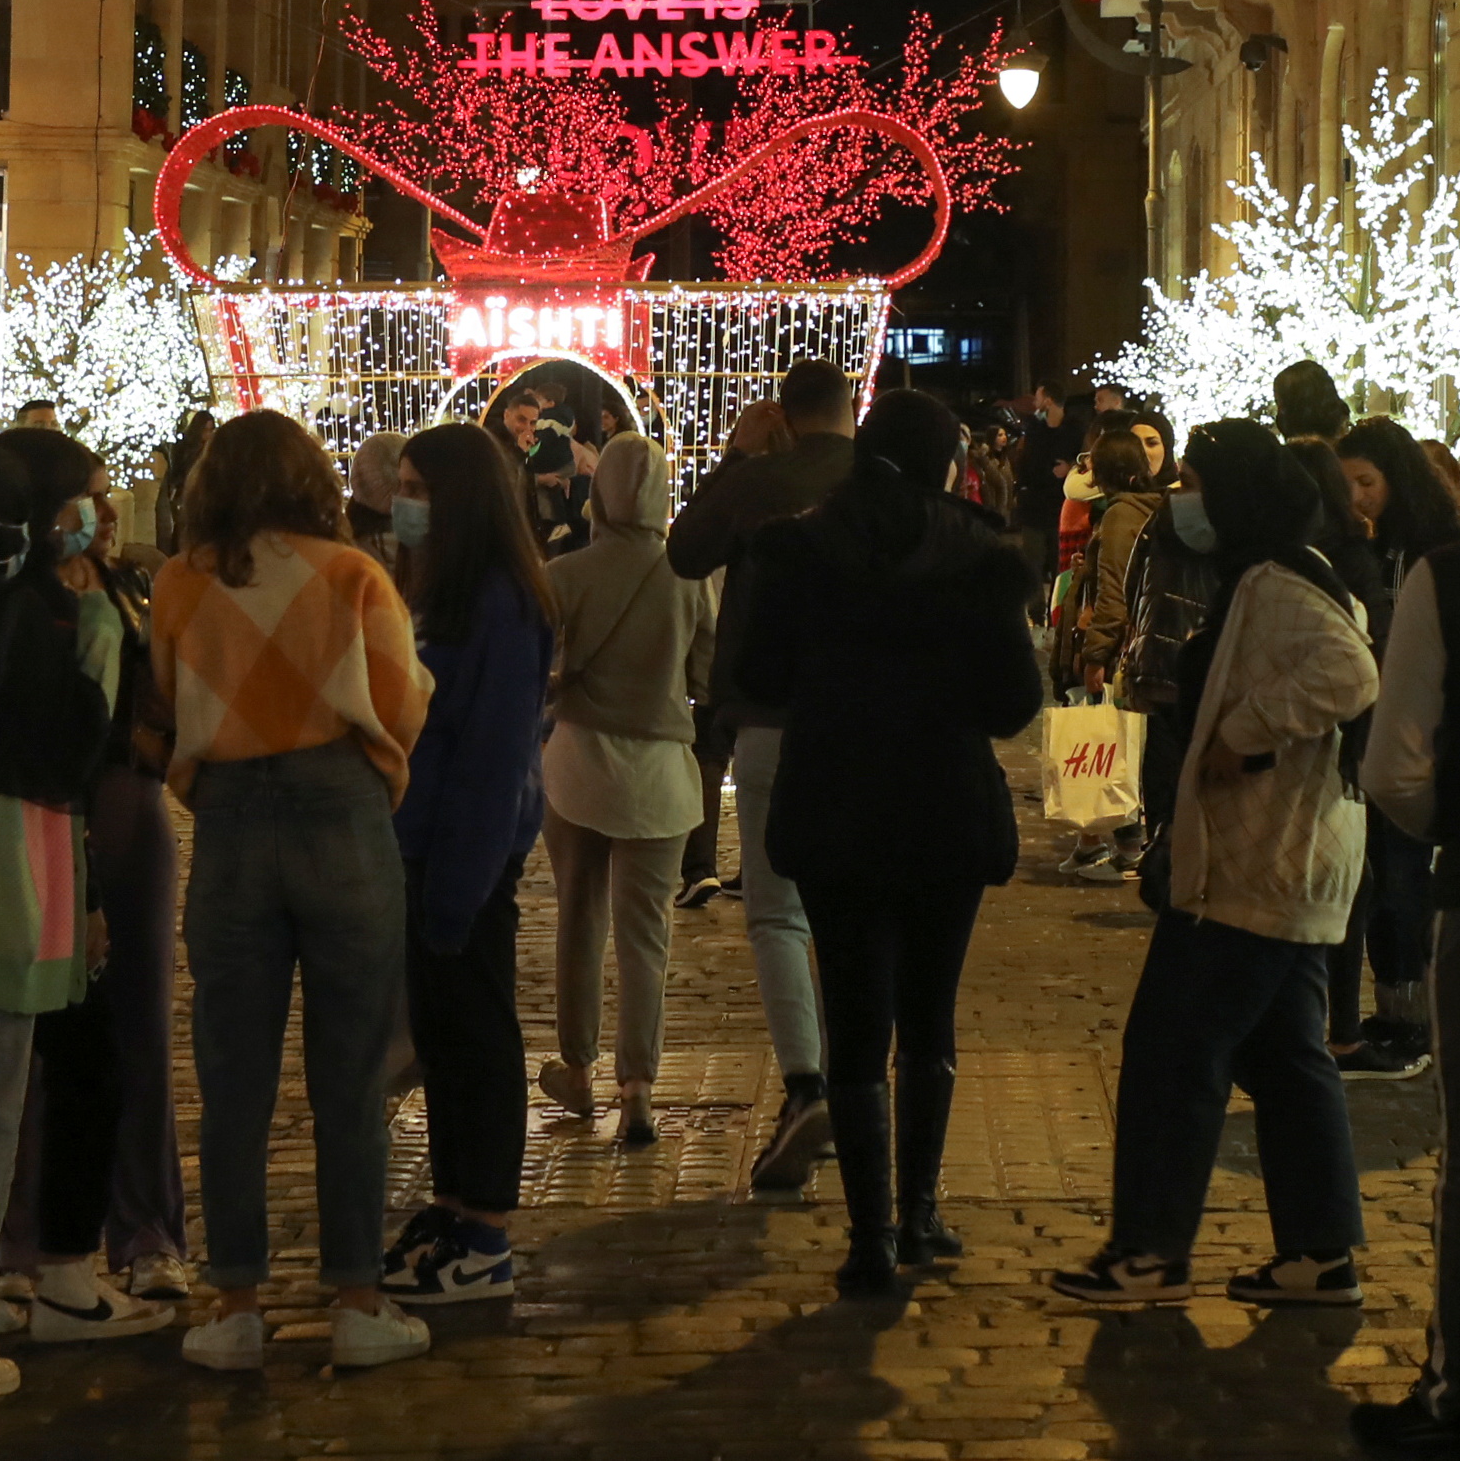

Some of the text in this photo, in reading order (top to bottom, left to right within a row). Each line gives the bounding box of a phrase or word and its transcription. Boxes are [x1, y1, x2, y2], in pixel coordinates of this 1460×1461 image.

[467, 29, 839, 79] THE ANSWER
[453, 295, 622, 349] AÏSHTI
[1062, 742, 1117, 779] H&M
